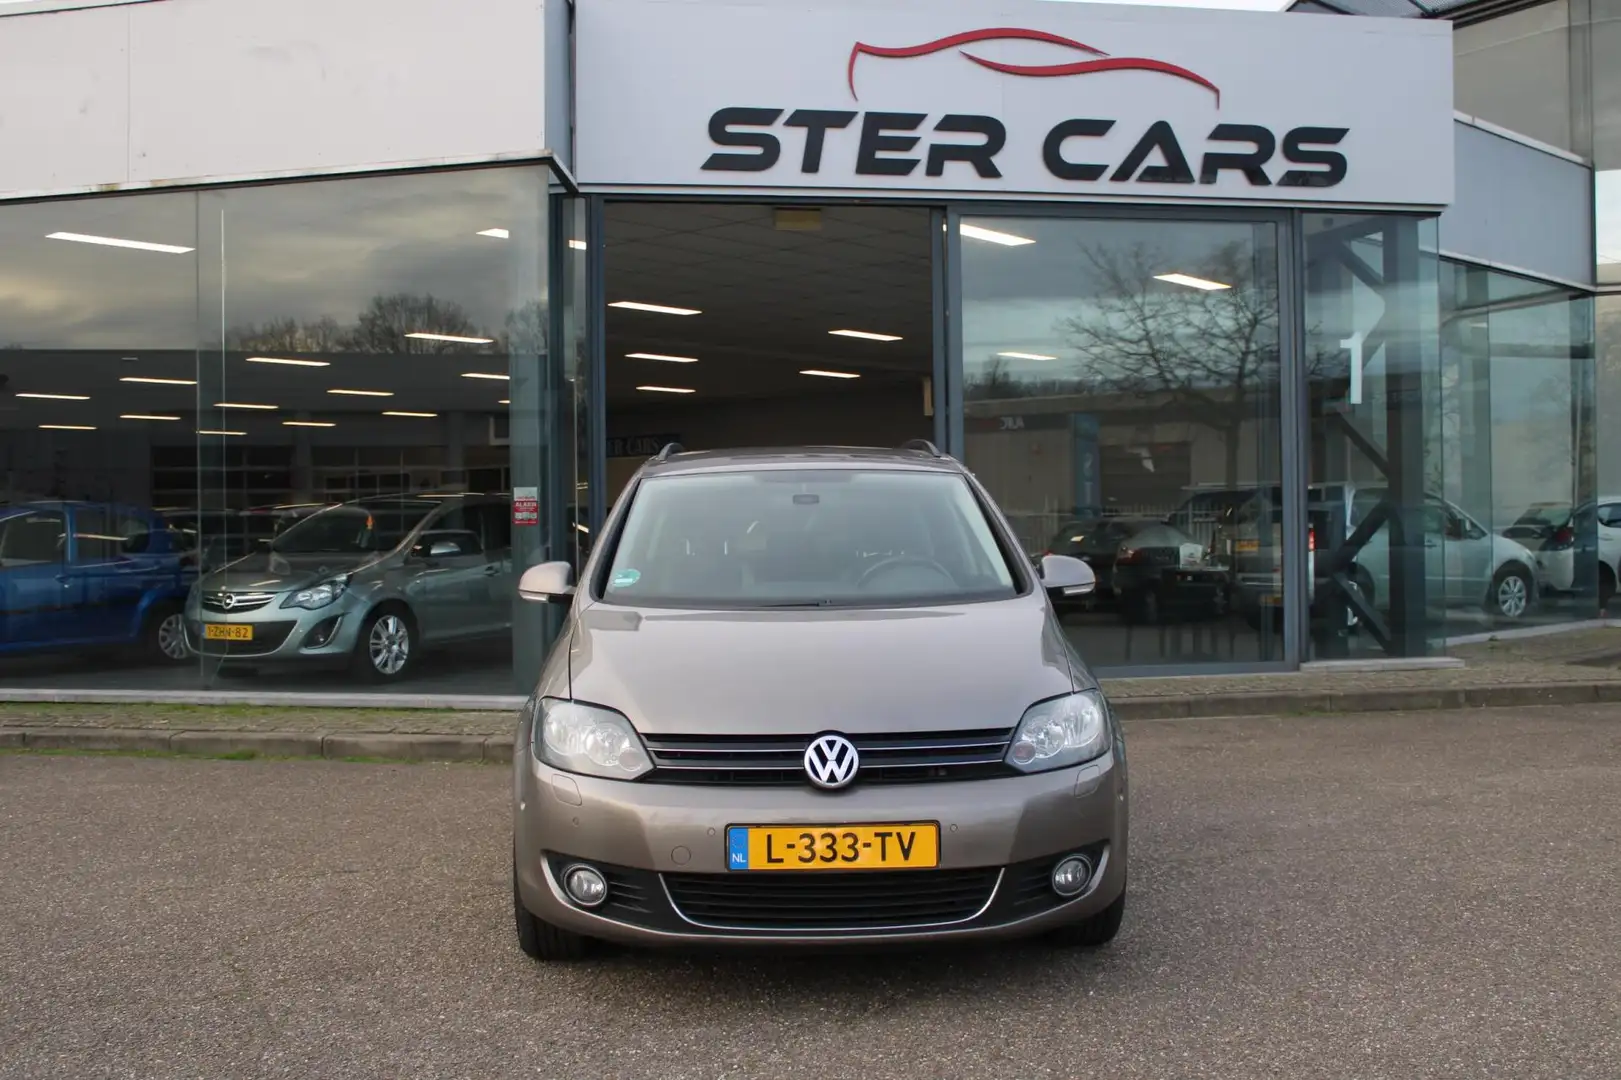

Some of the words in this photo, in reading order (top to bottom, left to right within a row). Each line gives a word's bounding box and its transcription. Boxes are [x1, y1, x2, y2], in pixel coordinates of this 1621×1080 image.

[700, 107, 1006, 178] STER
[1042, 119, 1350, 188] CARS
[732, 853, 746, 863] NL
[766, 831, 916, 864] L-333-TV
